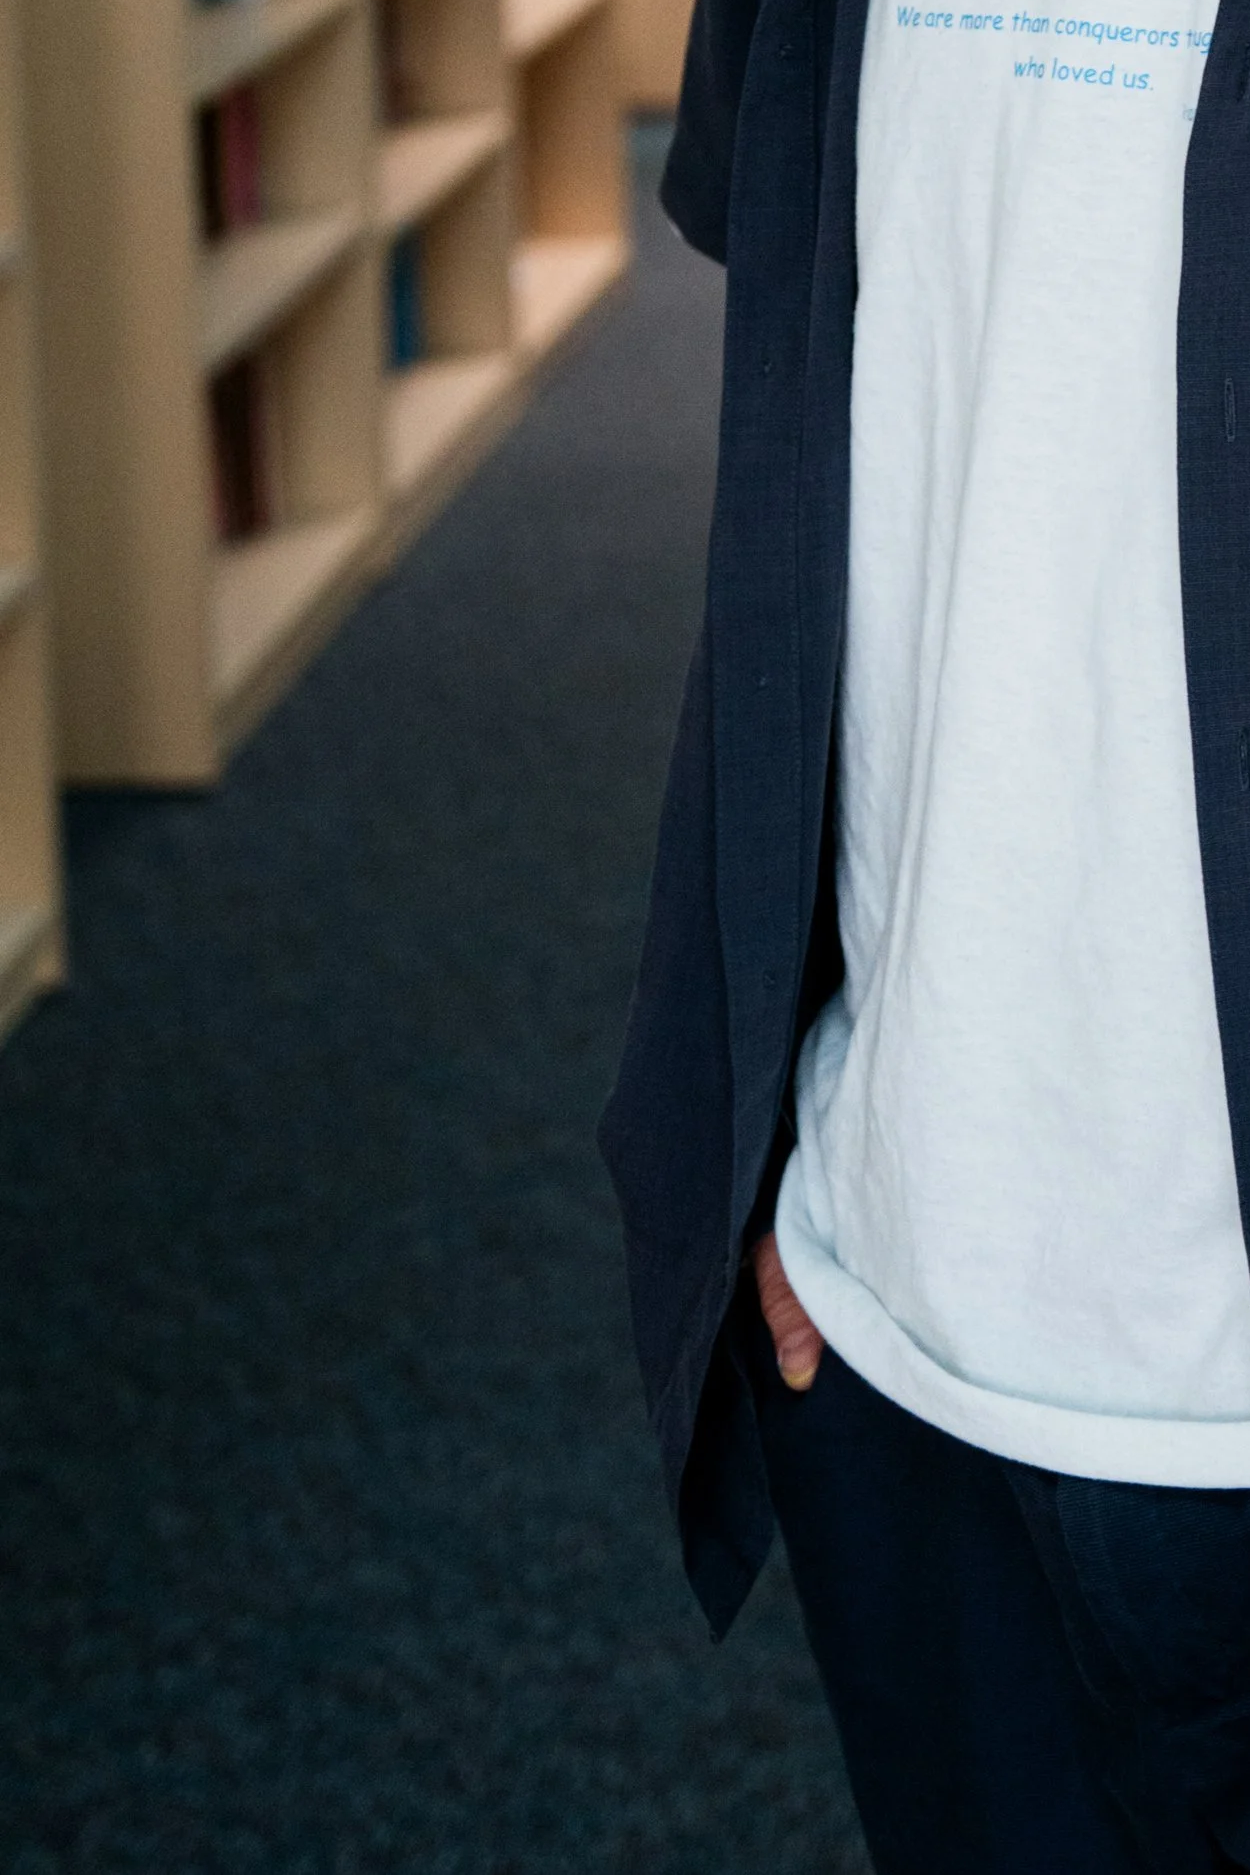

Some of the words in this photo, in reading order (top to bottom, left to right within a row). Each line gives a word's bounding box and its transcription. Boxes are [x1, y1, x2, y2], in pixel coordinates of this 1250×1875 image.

[897, 5, 921, 27] We
[924, 12, 953, 28] are
[959, 14, 1004, 30] more
[1012, 11, 1049, 33] than
[1054, 18, 1180, 47] conquerors
[1014, 56, 1045, 78] who
[1051, 57, 1115, 85] loved
[1123, 73, 1154, 91] us.
